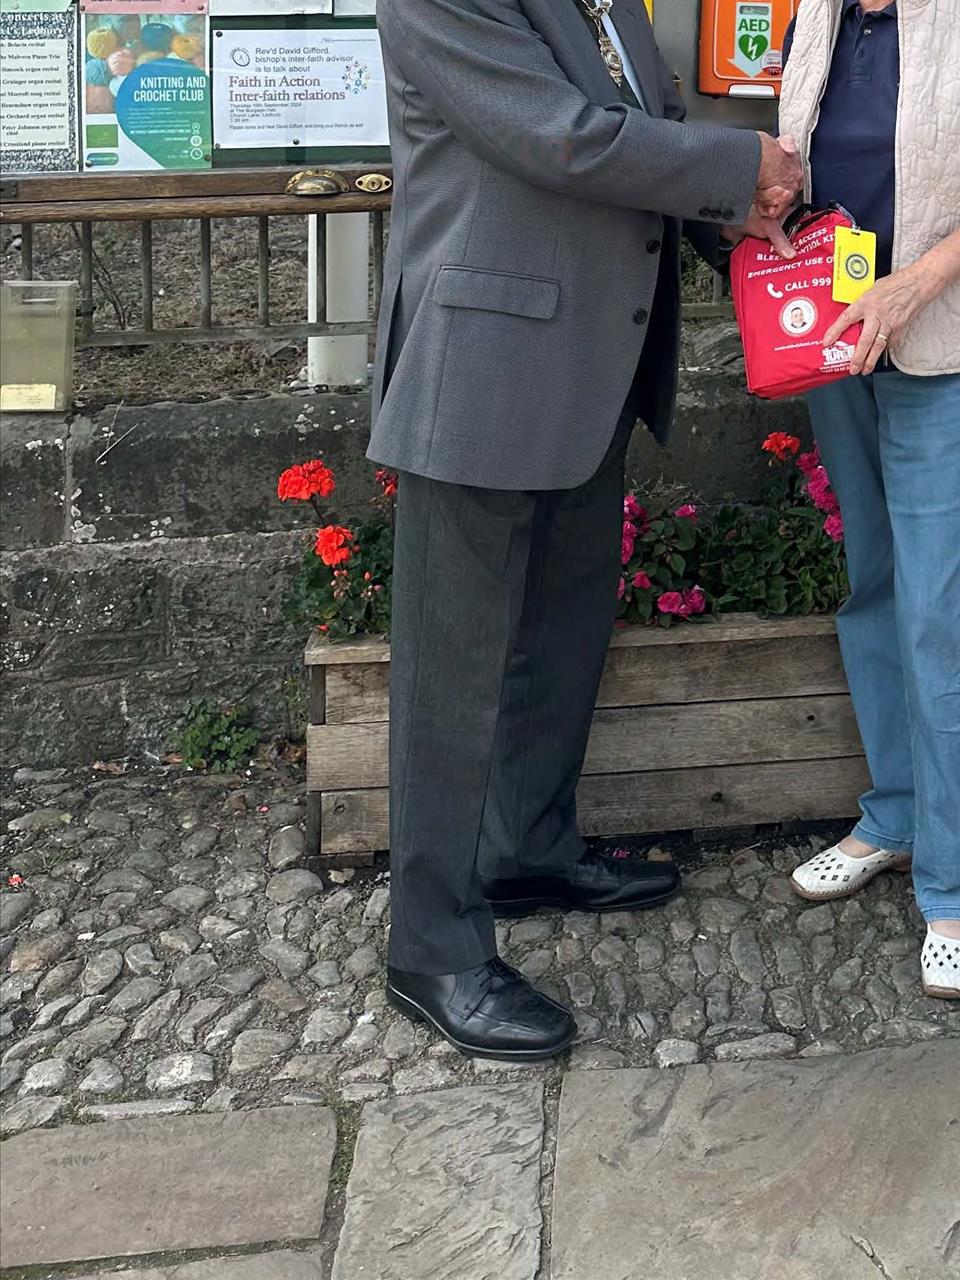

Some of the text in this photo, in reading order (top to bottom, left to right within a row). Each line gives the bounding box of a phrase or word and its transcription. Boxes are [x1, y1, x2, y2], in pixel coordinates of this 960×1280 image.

[738, 18, 770, 31] AED
[255, 47, 277, 55] Rev'd
[279, 47, 301, 55] David
[255, 56, 287, 64] bishop's
[288, 55, 324, 63] inter-faith
[255, 65, 311, 73] is to talk about
[140, 76, 206, 88] KNITTING AND
[229, 75, 320, 87] Faith in Action
[133, 89, 205, 102] CROCHET CLUB
[229, 89, 345, 101] Inter-faith relations
[798, 227, 828, 245] ACCESS
[747, 261, 803, 279] EMERGENCY
[804, 257, 823, 266] USE
[785, 277, 831, 291] CALL 999
